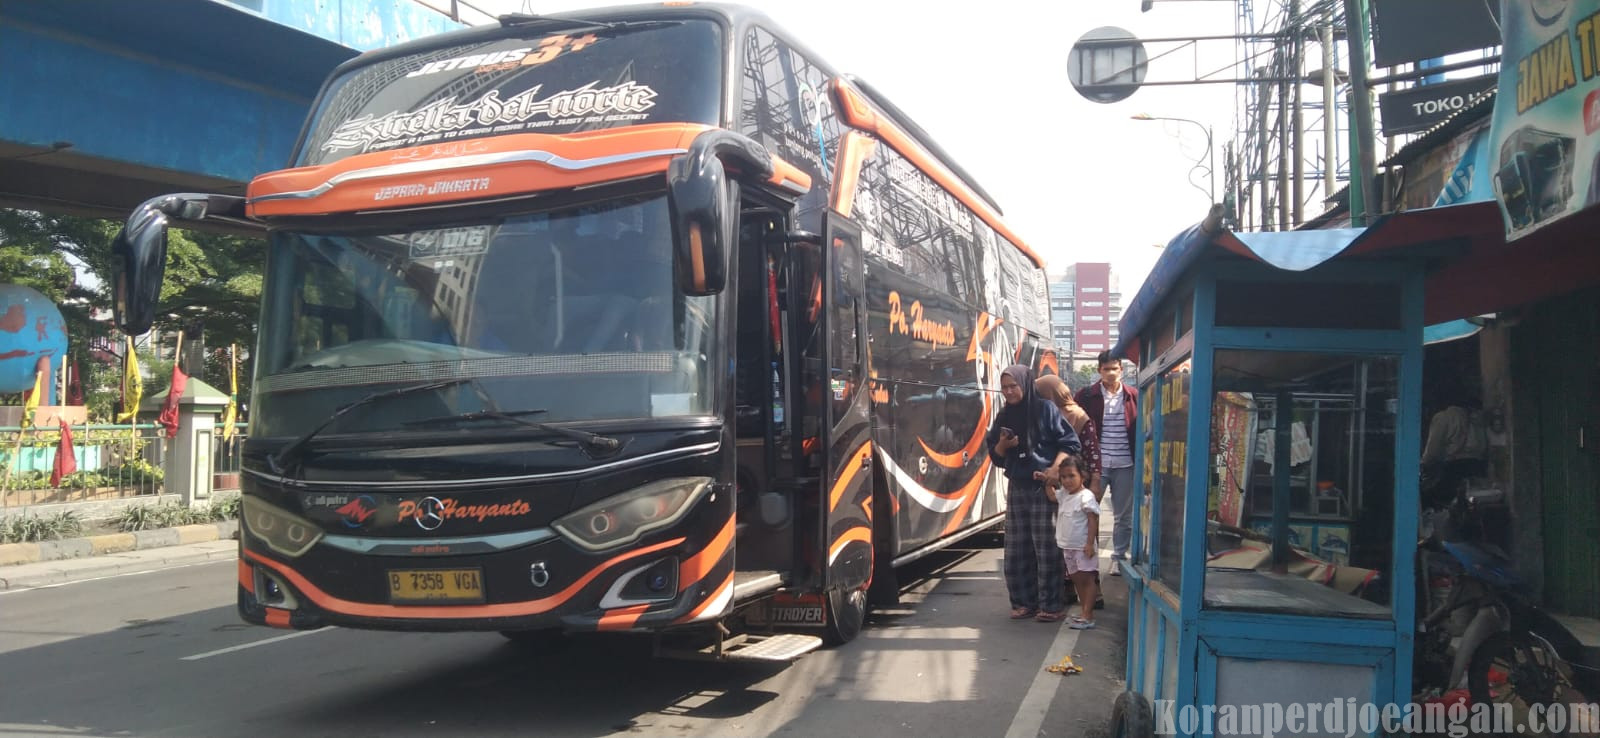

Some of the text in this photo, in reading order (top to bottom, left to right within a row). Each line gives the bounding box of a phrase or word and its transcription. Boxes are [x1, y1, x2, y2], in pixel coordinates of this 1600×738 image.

[1516, 28, 1577, 116] JAWA
[1412, 95, 1464, 115] TOKO
[321, 95, 476, 153] Estrella
[444, 131, 458, 139] TO
[494, 123, 525, 132] MORE
[527, 120, 555, 129] THAN
[556, 117, 584, 125] JUST
[605, 113, 650, 122] SECRET
[911, 299, 955, 352] Haryanto
[436, 498, 532, 523] Haryanto
[391, 572, 480, 592] B 7358 VGA
